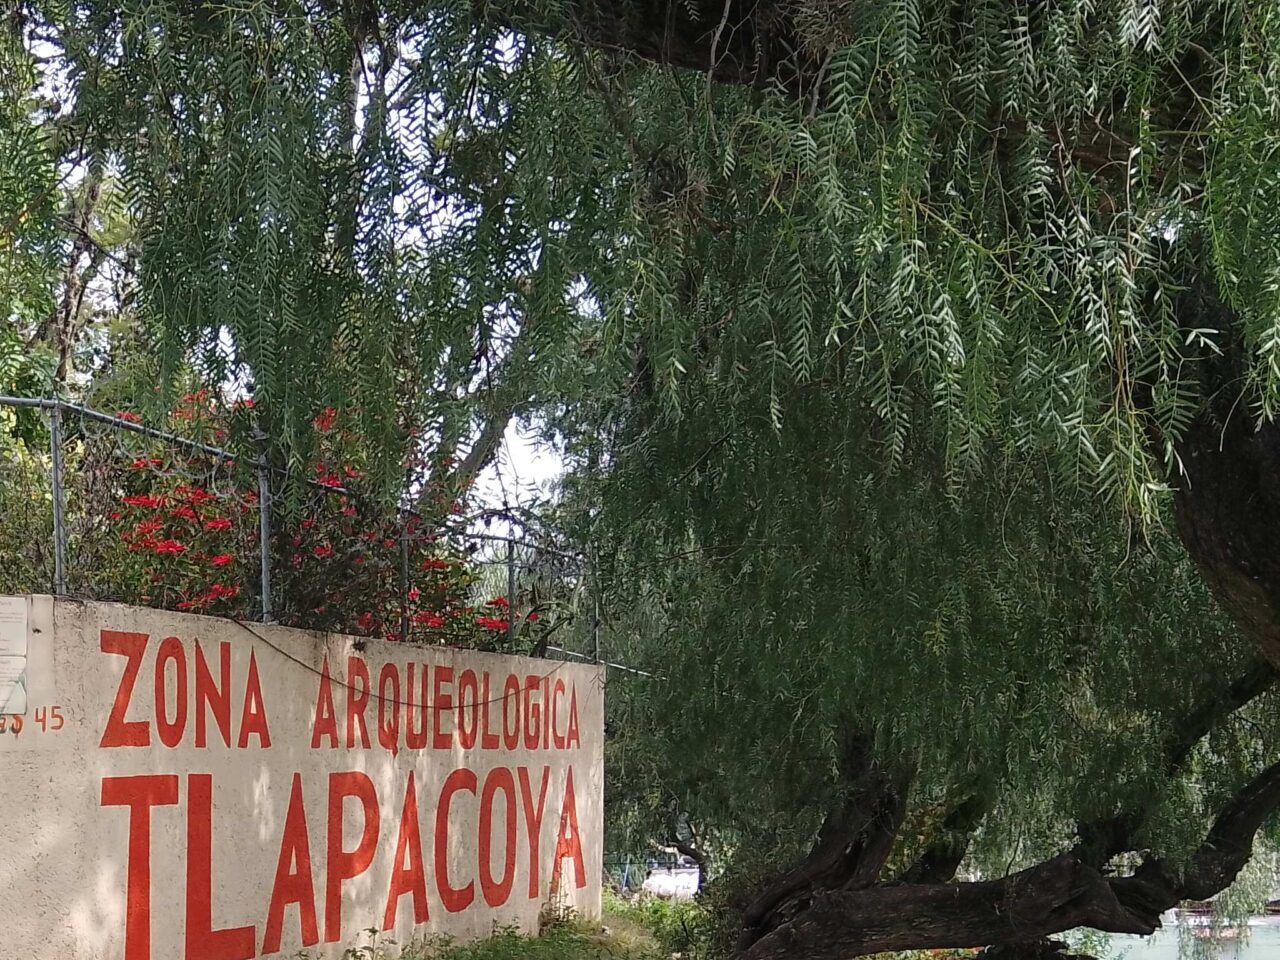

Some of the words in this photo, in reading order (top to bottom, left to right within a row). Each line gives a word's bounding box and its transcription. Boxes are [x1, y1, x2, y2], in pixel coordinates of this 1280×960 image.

[33, 705, 65, 733] 45
[99, 629, 272, 749] ZONA
[310, 652, 581, 759] ARQUEOLOGICA
